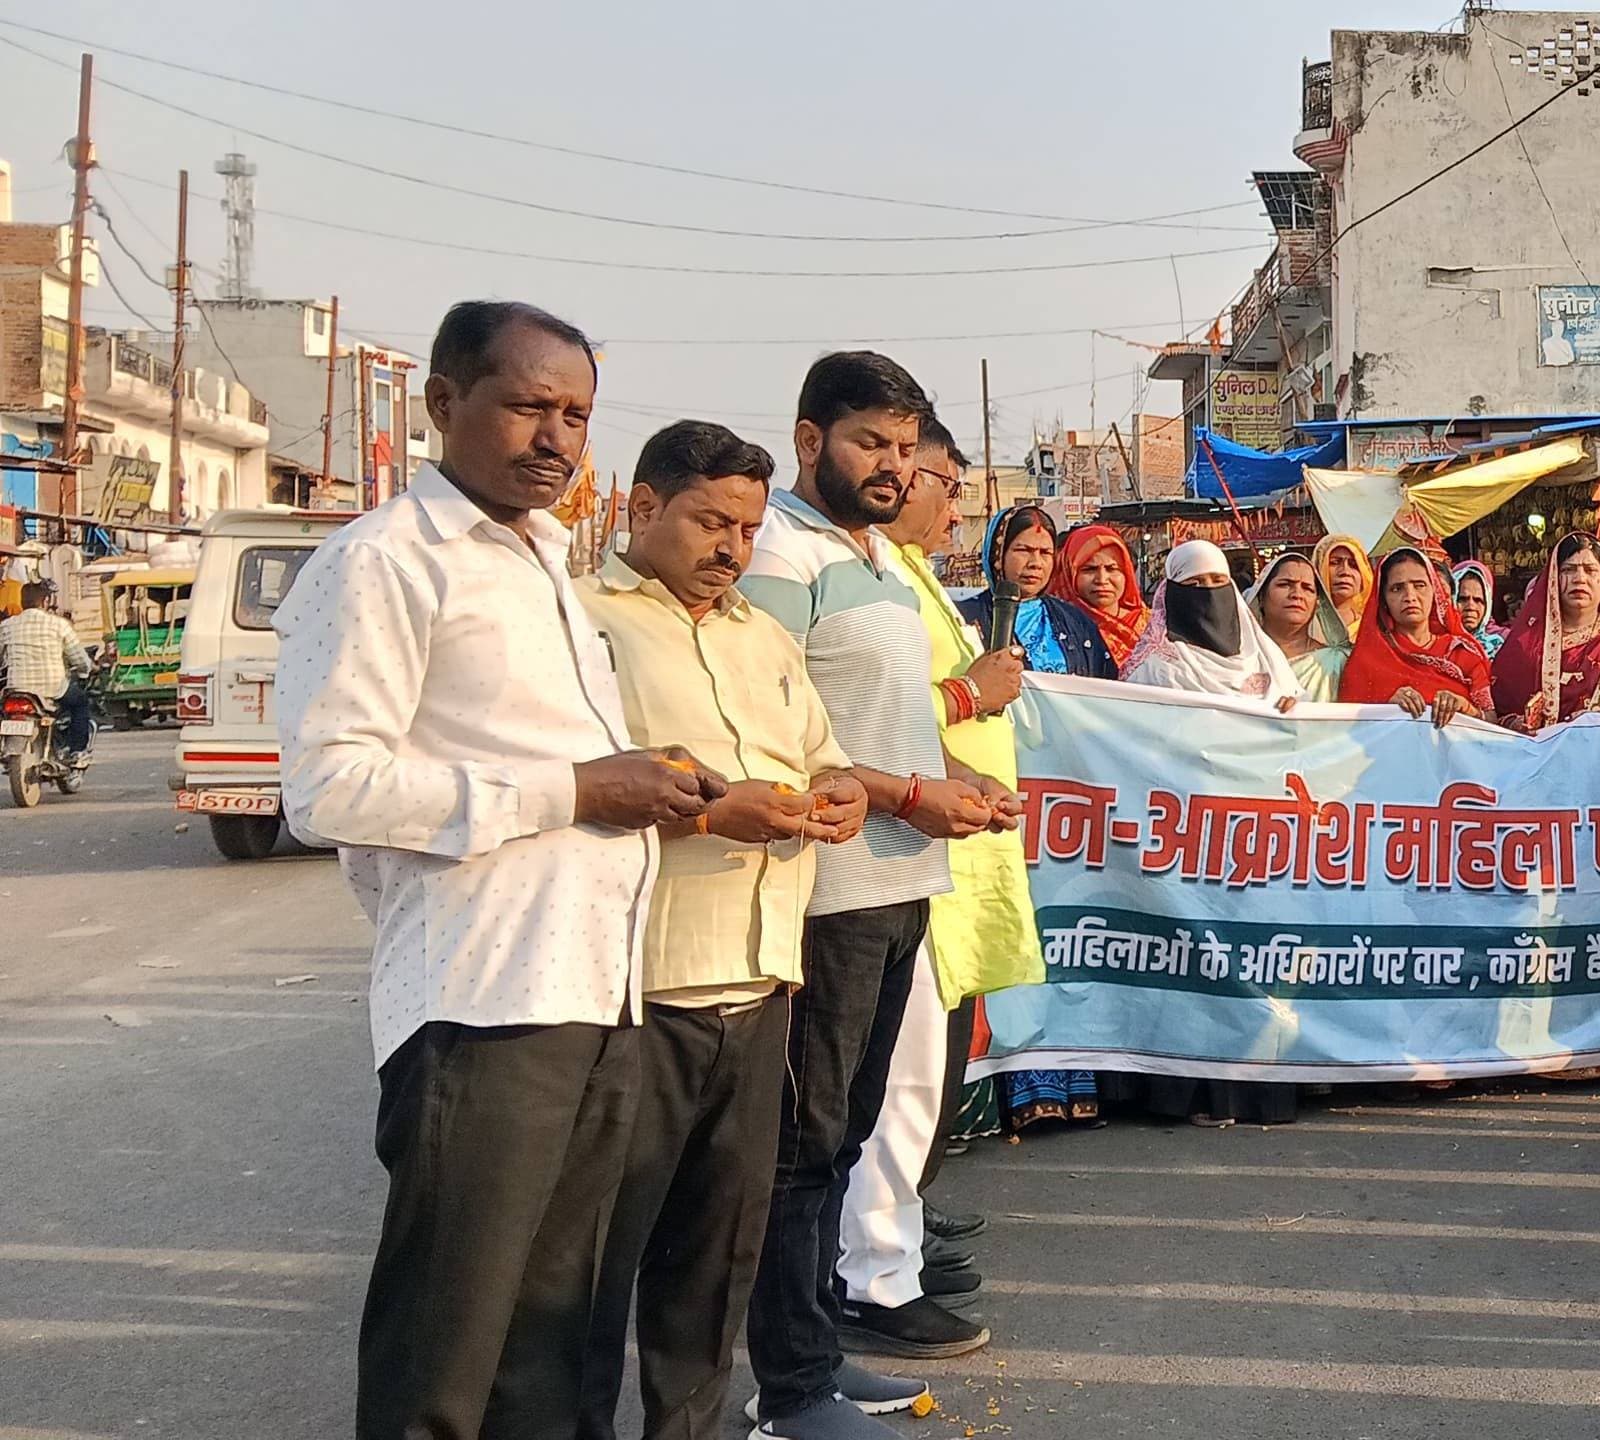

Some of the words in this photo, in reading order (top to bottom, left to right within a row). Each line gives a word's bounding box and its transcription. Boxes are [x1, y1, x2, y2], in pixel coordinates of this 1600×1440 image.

[1215, 374, 1256, 402] सुनिल
[200, 794, 273, 810] STOP
[1383, 782, 1579, 889] महिला
[1043, 917, 1195, 977] महिलाओं
[1200, 931, 1232, 981] के
[1239, 934, 1371, 986] अधिकारों
[1371, 946, 1408, 985] पर
[1412, 947, 1466, 984] वार
